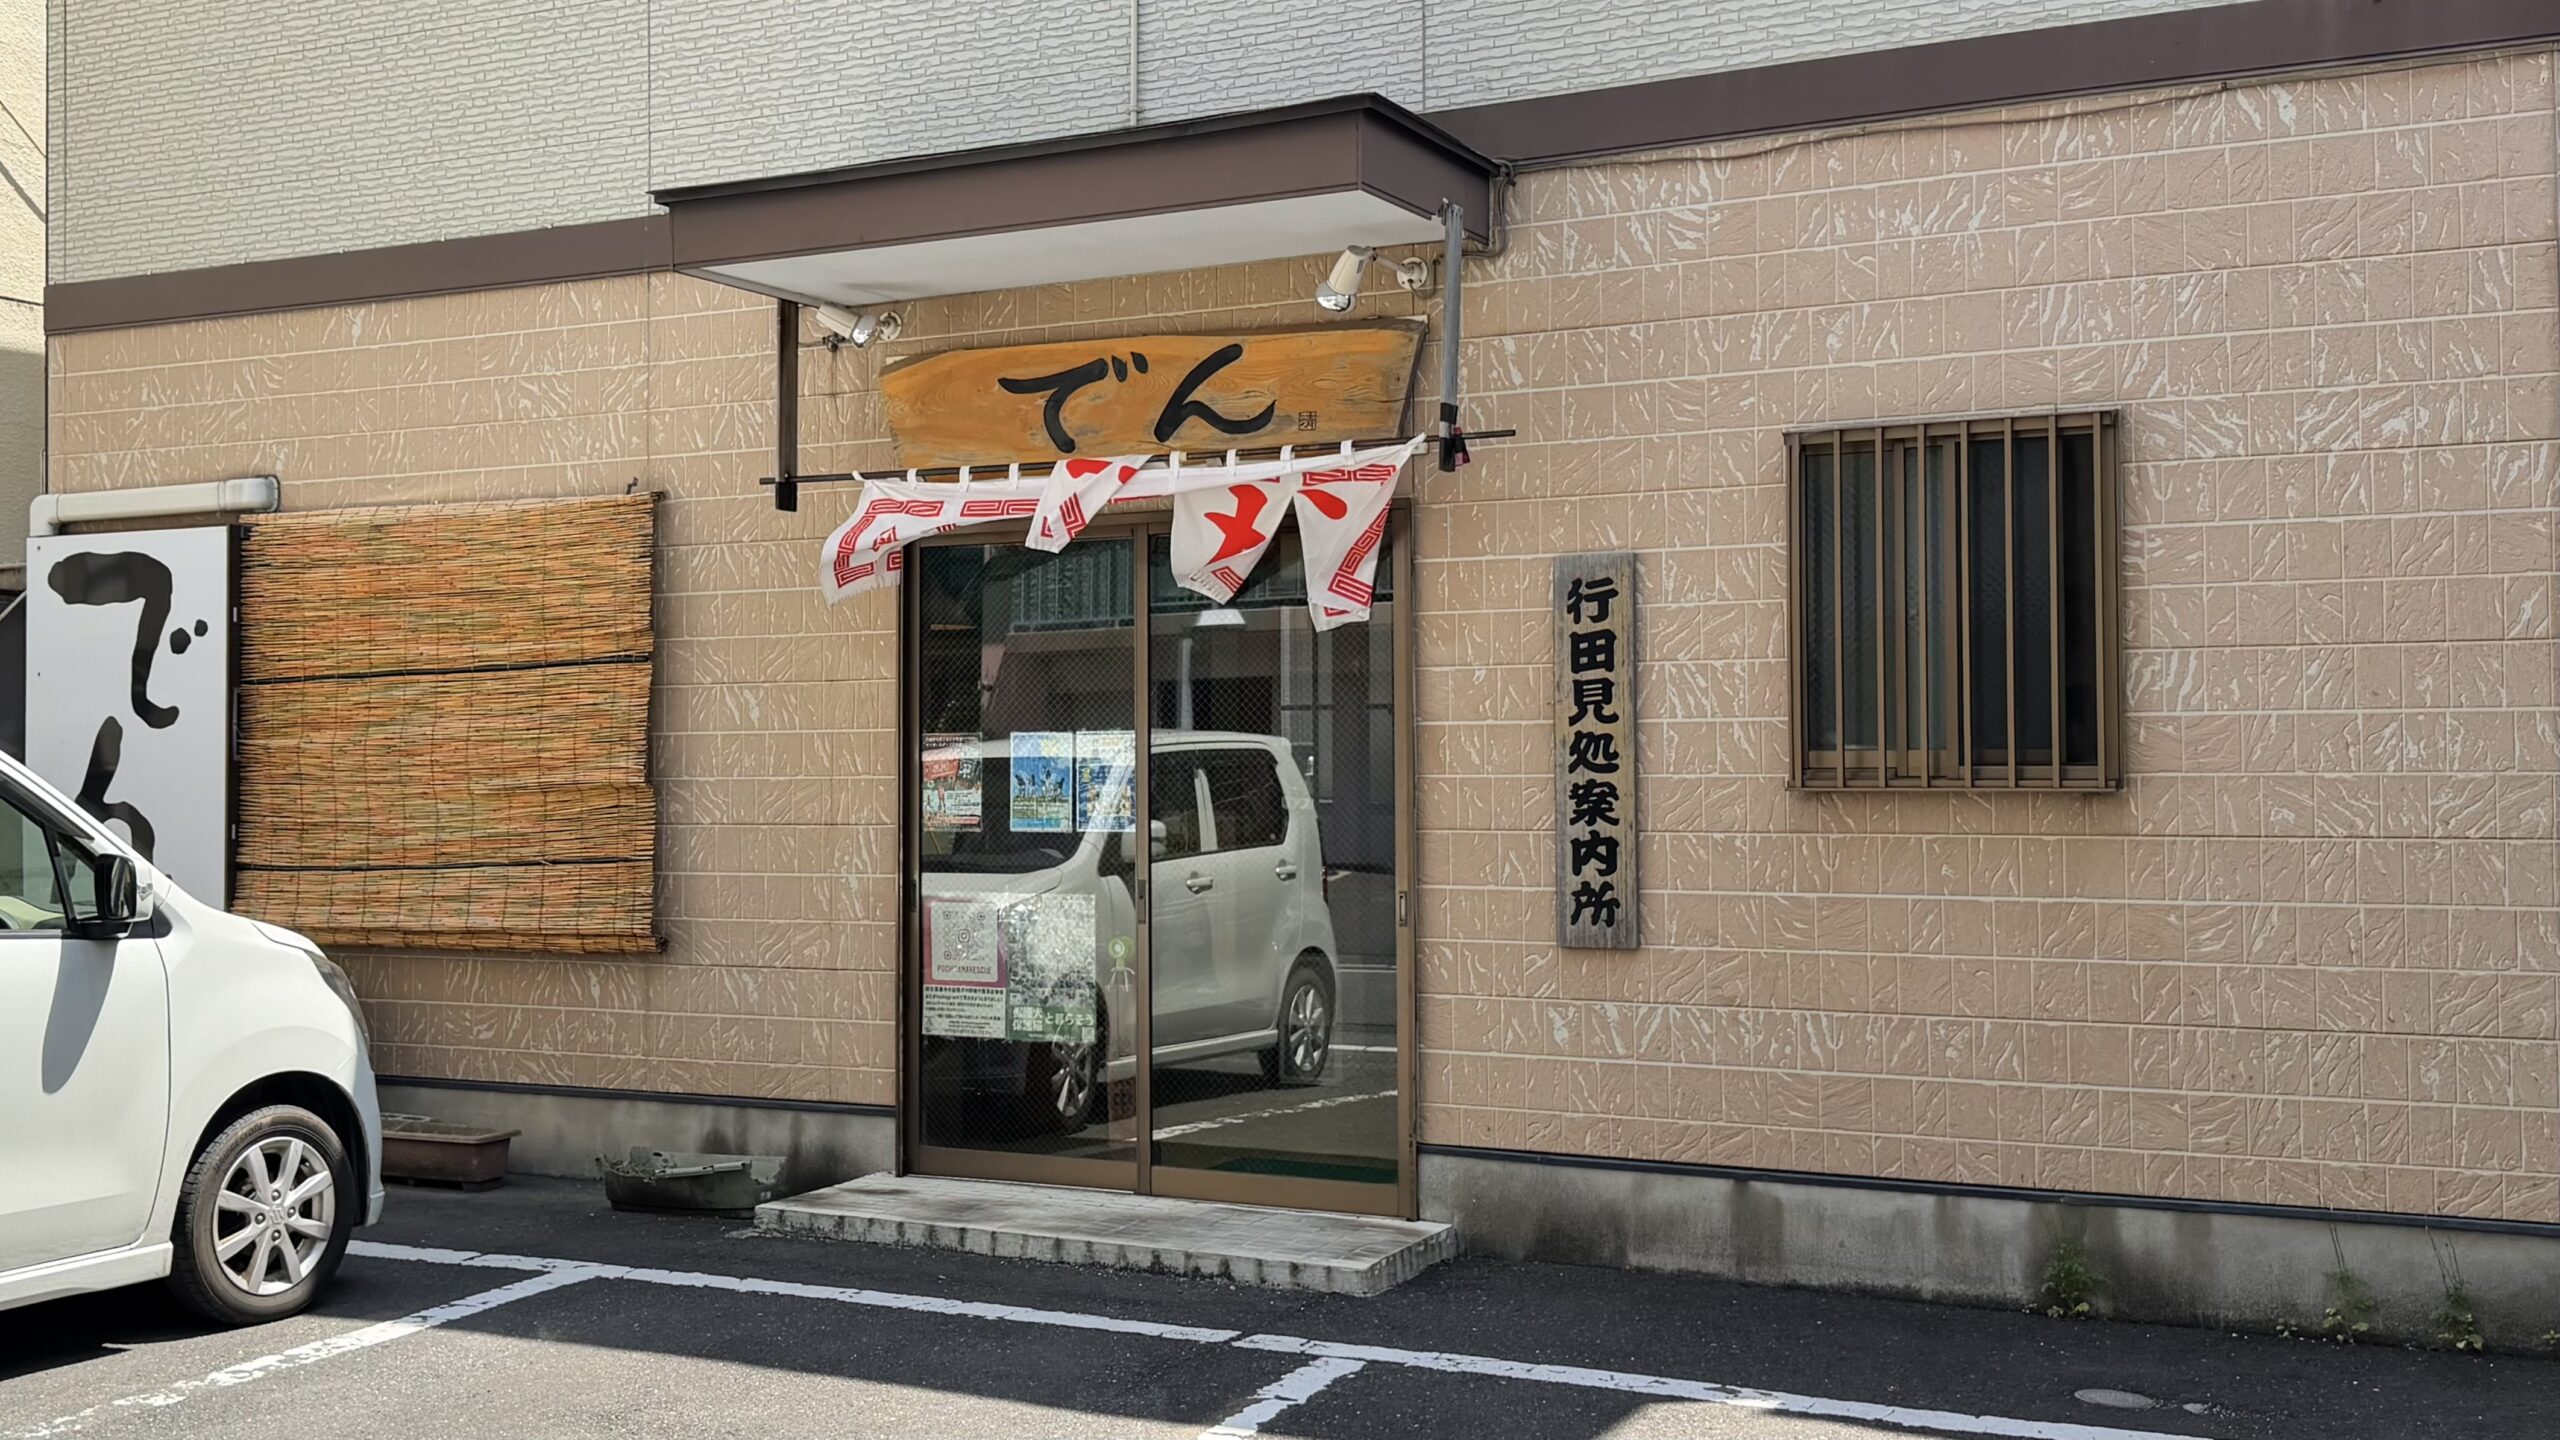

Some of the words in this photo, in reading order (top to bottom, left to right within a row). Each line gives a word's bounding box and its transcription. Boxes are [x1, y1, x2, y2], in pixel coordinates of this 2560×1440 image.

[998, 343, 1276, 454] でん
[1567, 576, 1620, 928] 行田見処案内所
